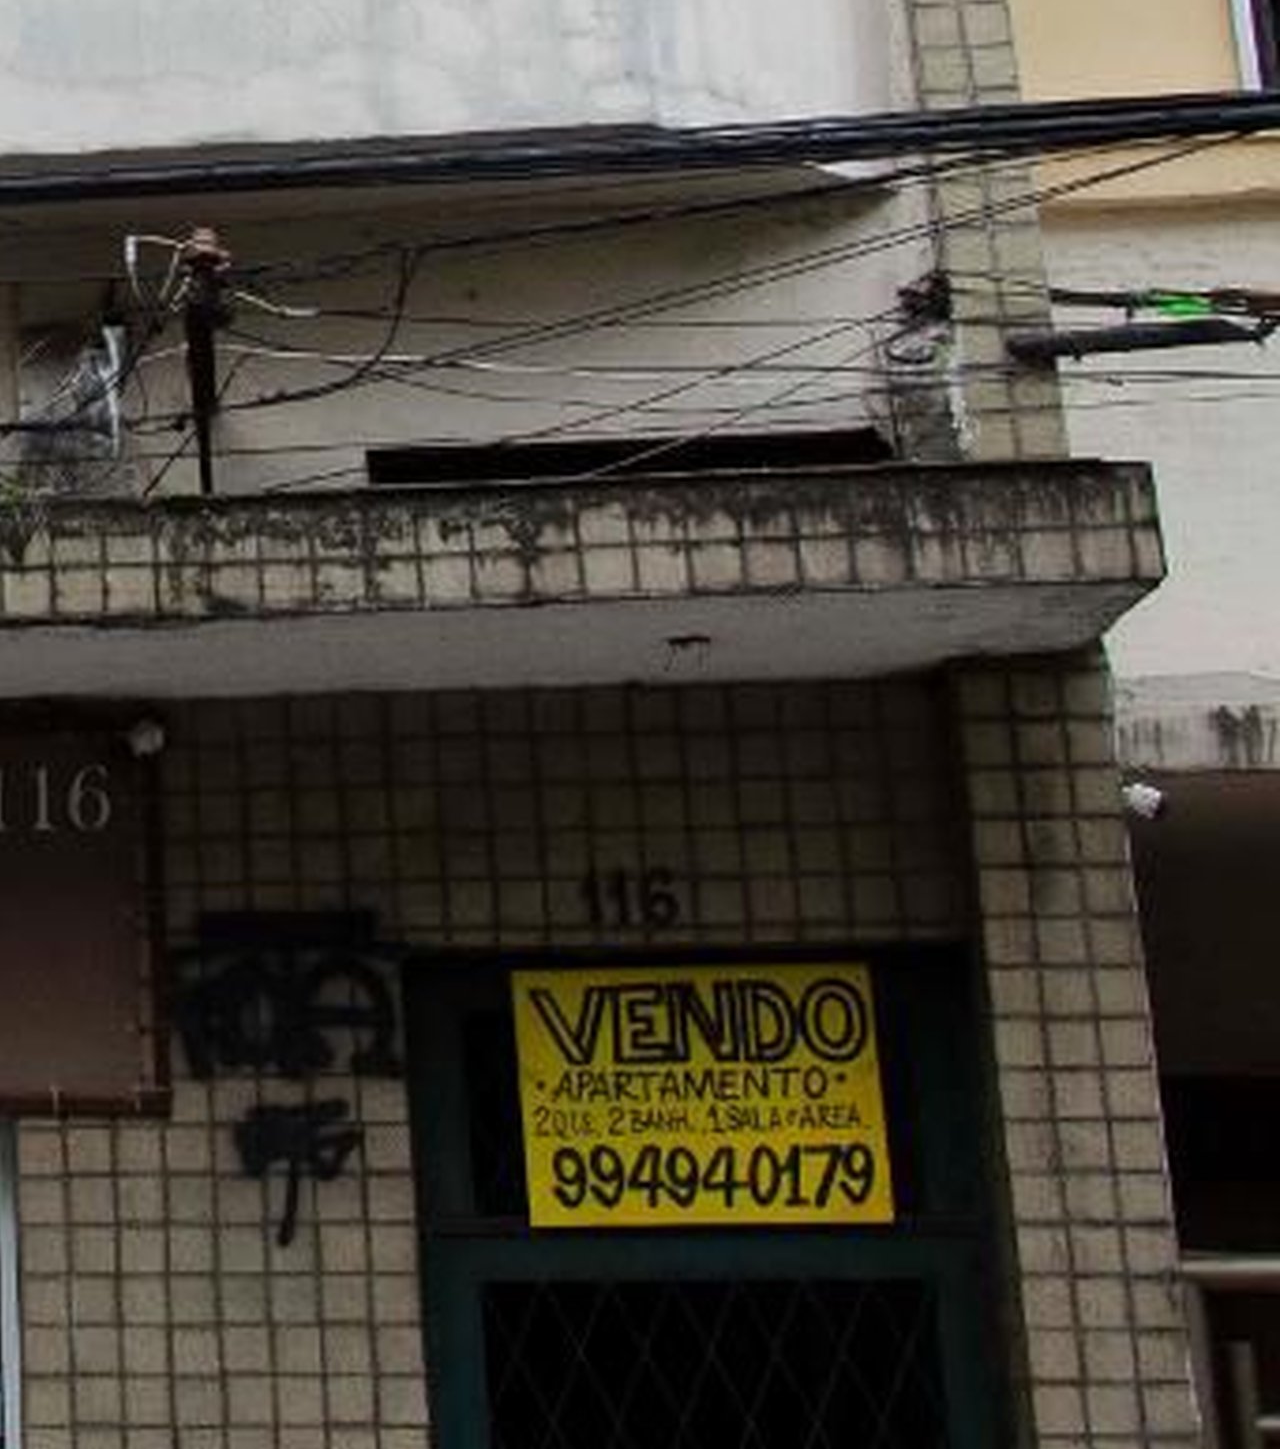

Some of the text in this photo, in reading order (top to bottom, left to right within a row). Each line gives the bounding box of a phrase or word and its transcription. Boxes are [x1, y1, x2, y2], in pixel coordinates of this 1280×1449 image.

[581, 869, 681, 928] 116
[529, 978, 870, 1065] VENDO
[552, 1065, 829, 1102] APARTAMENTO
